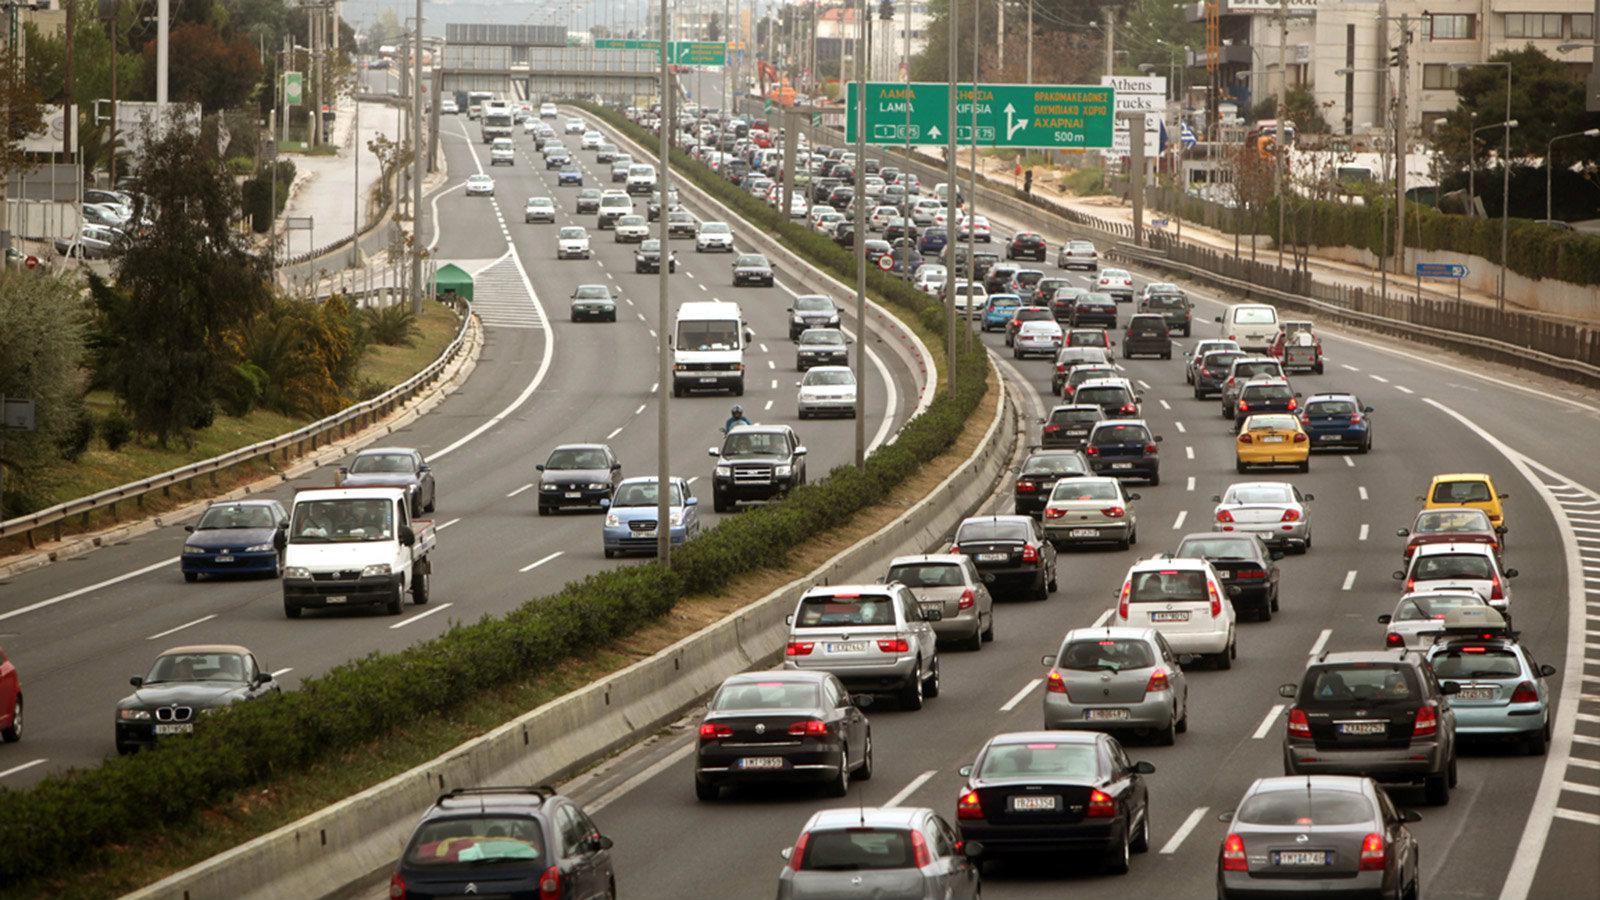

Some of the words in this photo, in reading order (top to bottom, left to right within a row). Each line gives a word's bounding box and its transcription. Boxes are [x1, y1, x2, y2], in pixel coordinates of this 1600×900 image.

[1111, 79, 1152, 91] Athens
[880, 102, 915, 112] LAMIA
[1116, 97, 1152, 109] rucks
